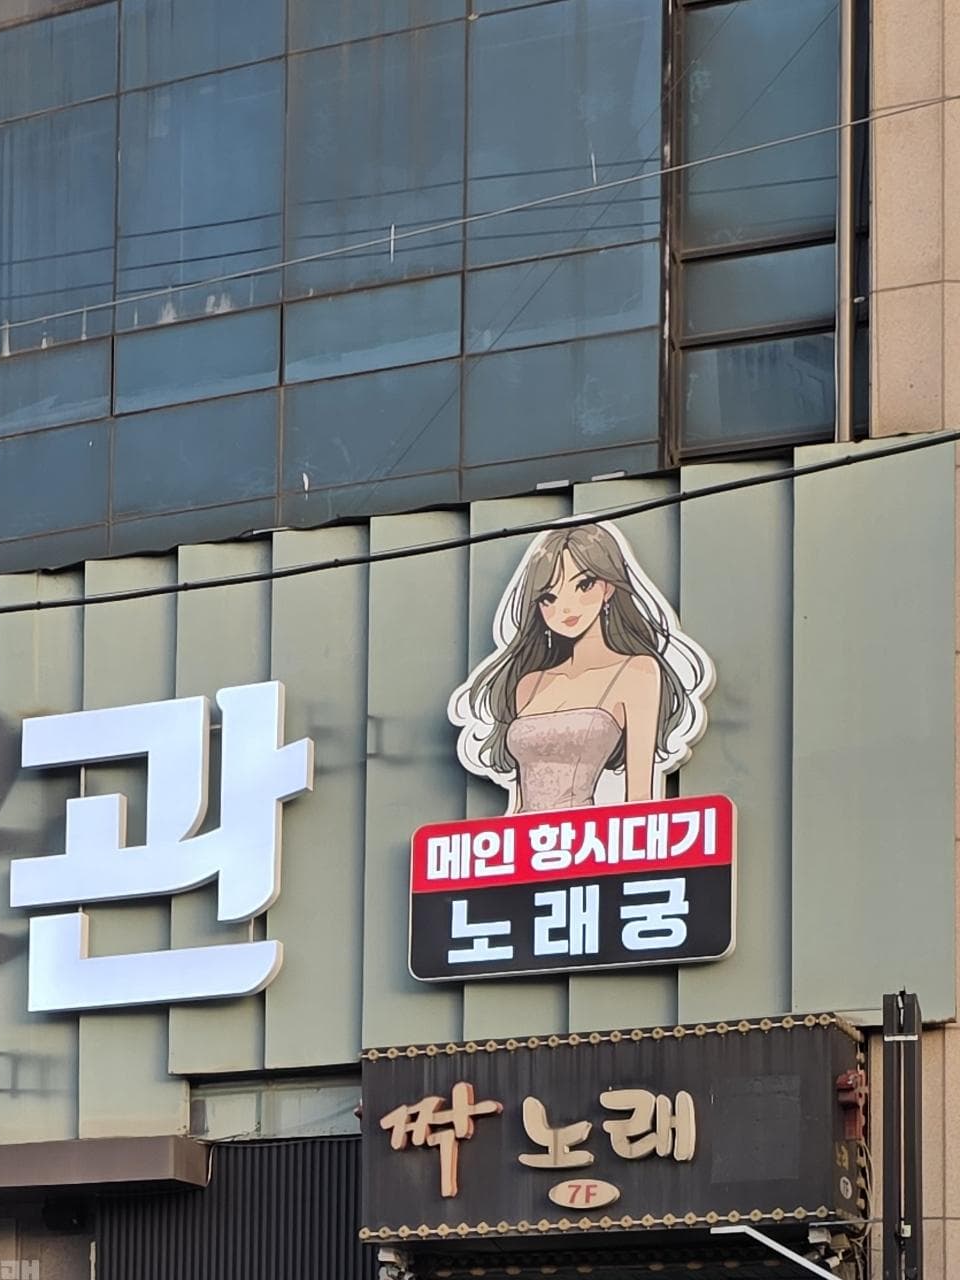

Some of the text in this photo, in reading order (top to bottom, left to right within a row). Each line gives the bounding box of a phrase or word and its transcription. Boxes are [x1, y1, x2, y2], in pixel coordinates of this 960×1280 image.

[427, 807, 717, 881] 메인 항시대기
[447, 877, 690, 964] 노래궁
[379, 1080, 697, 1198] 짝 노래
[567, 1183, 599, 1205] 7F
